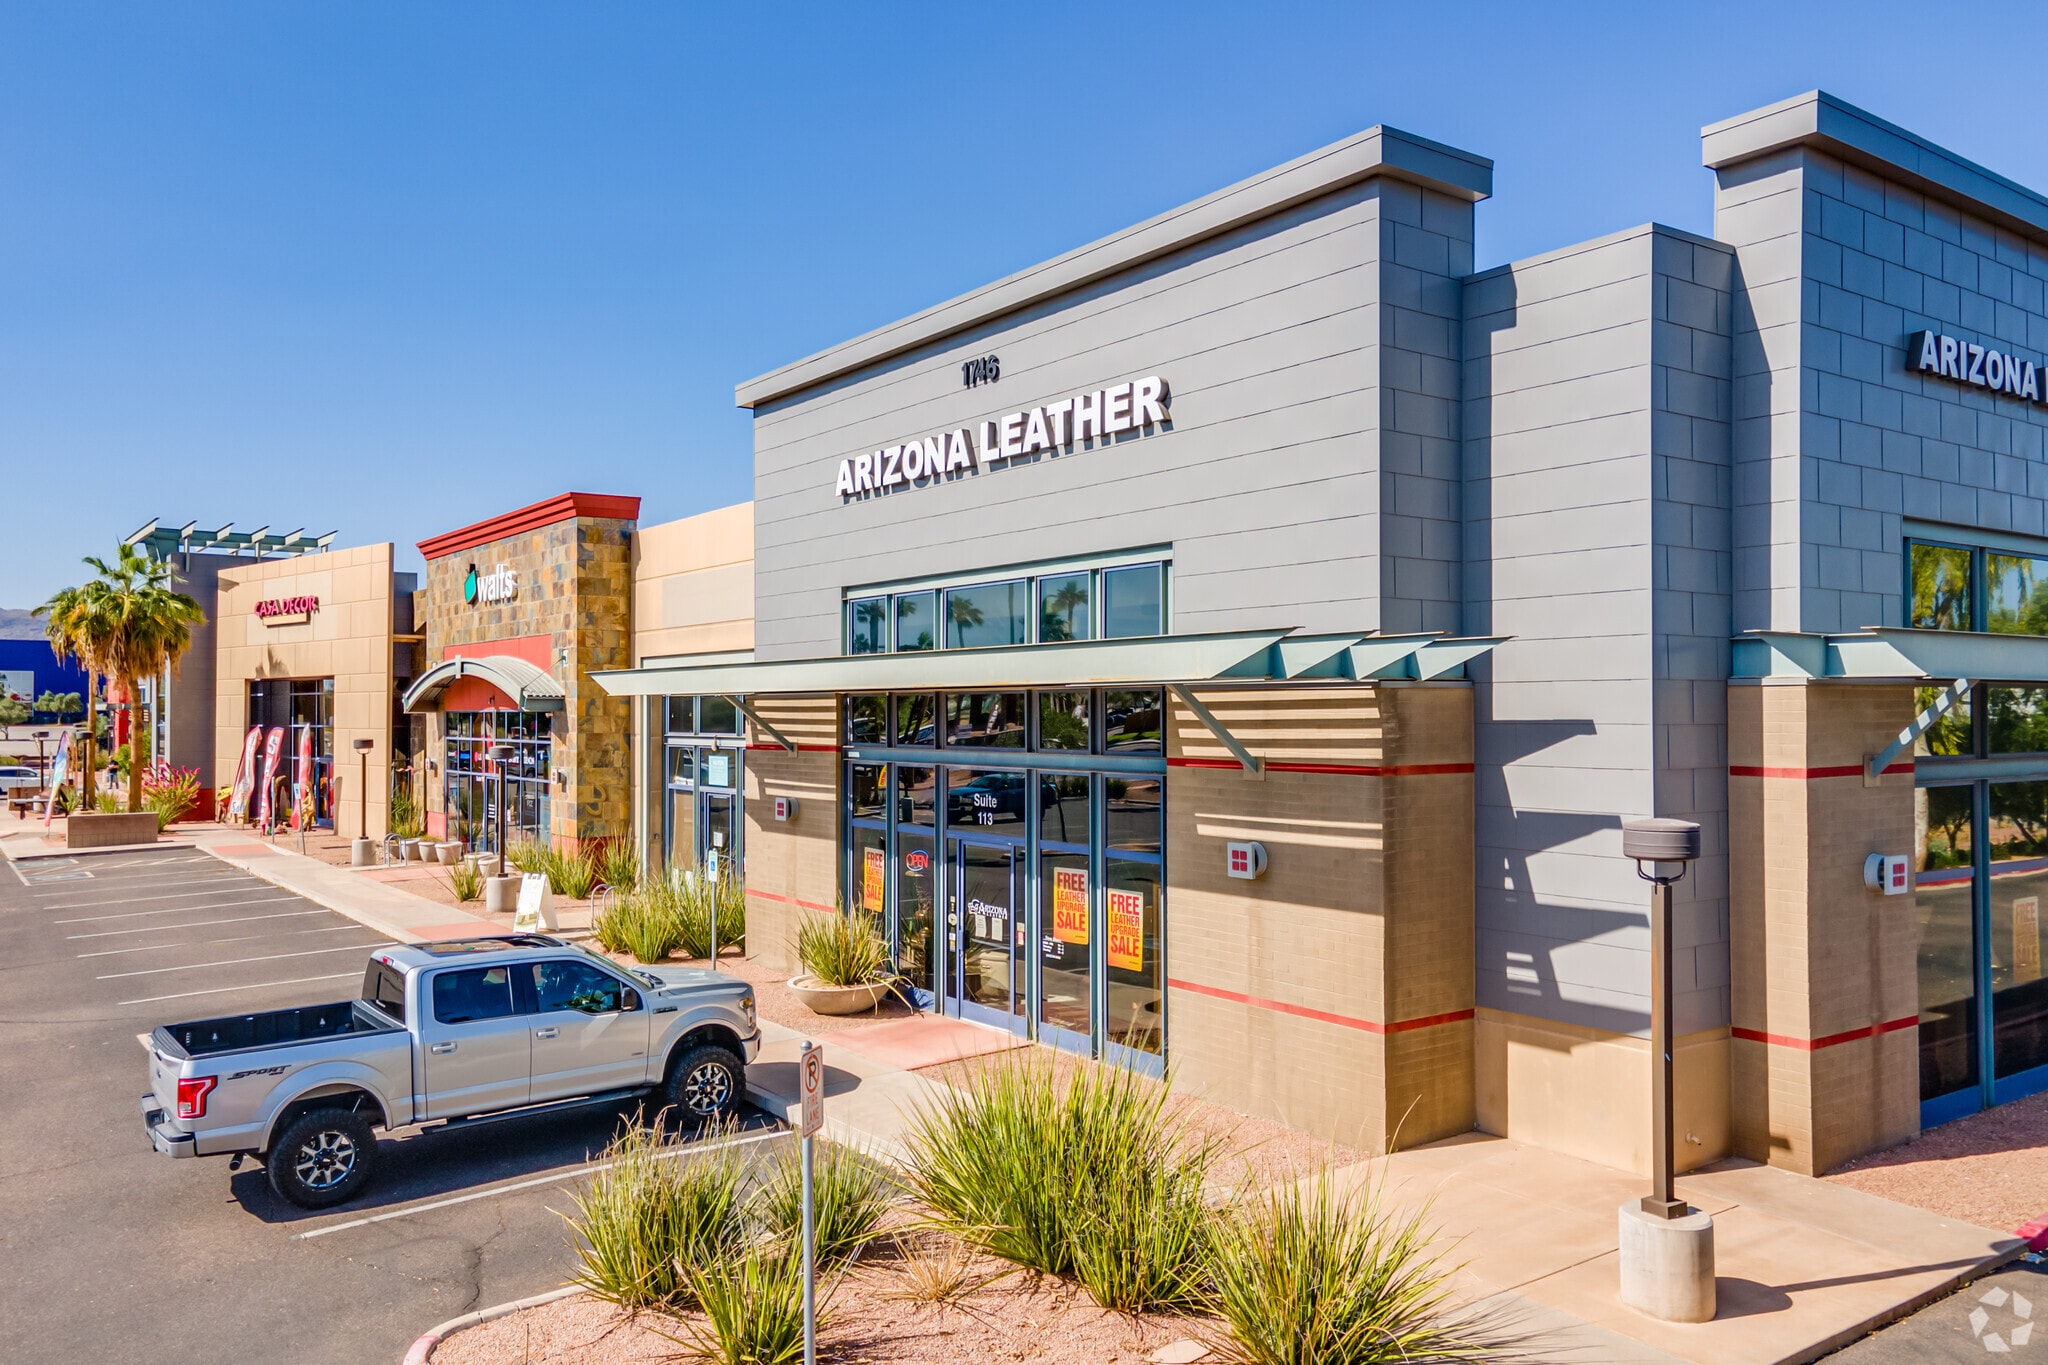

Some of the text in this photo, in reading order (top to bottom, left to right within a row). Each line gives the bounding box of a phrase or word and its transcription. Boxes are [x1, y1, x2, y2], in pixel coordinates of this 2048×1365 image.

[961, 354, 1000, 388] 1746
[1919, 329, 2039, 401] ARIZONA
[835, 375, 1170, 497] ARIZONA LEATHER
[254, 595, 317, 617] CASA DECOR
[973, 793, 998, 808] Suite
[977, 812, 994, 826] 113
[866, 851, 883, 869] FREE
[905, 853, 929, 869] OPEN
[1056, 871, 1086, 893] FREE
[865, 883, 882, 902] SALE
[1056, 889, 1086, 904] LEATHER
[1056, 899, 1086, 914] UPGRADE
[1110, 893, 1140, 916] FREE
[1056, 910, 1086, 932] SALE
[1110, 911, 1140, 928] LEATHER
[1110, 924, 1140, 939] UPGRADE
[1110, 934, 1140, 958] SALE
[227, 1064, 292, 1081] SPORT
